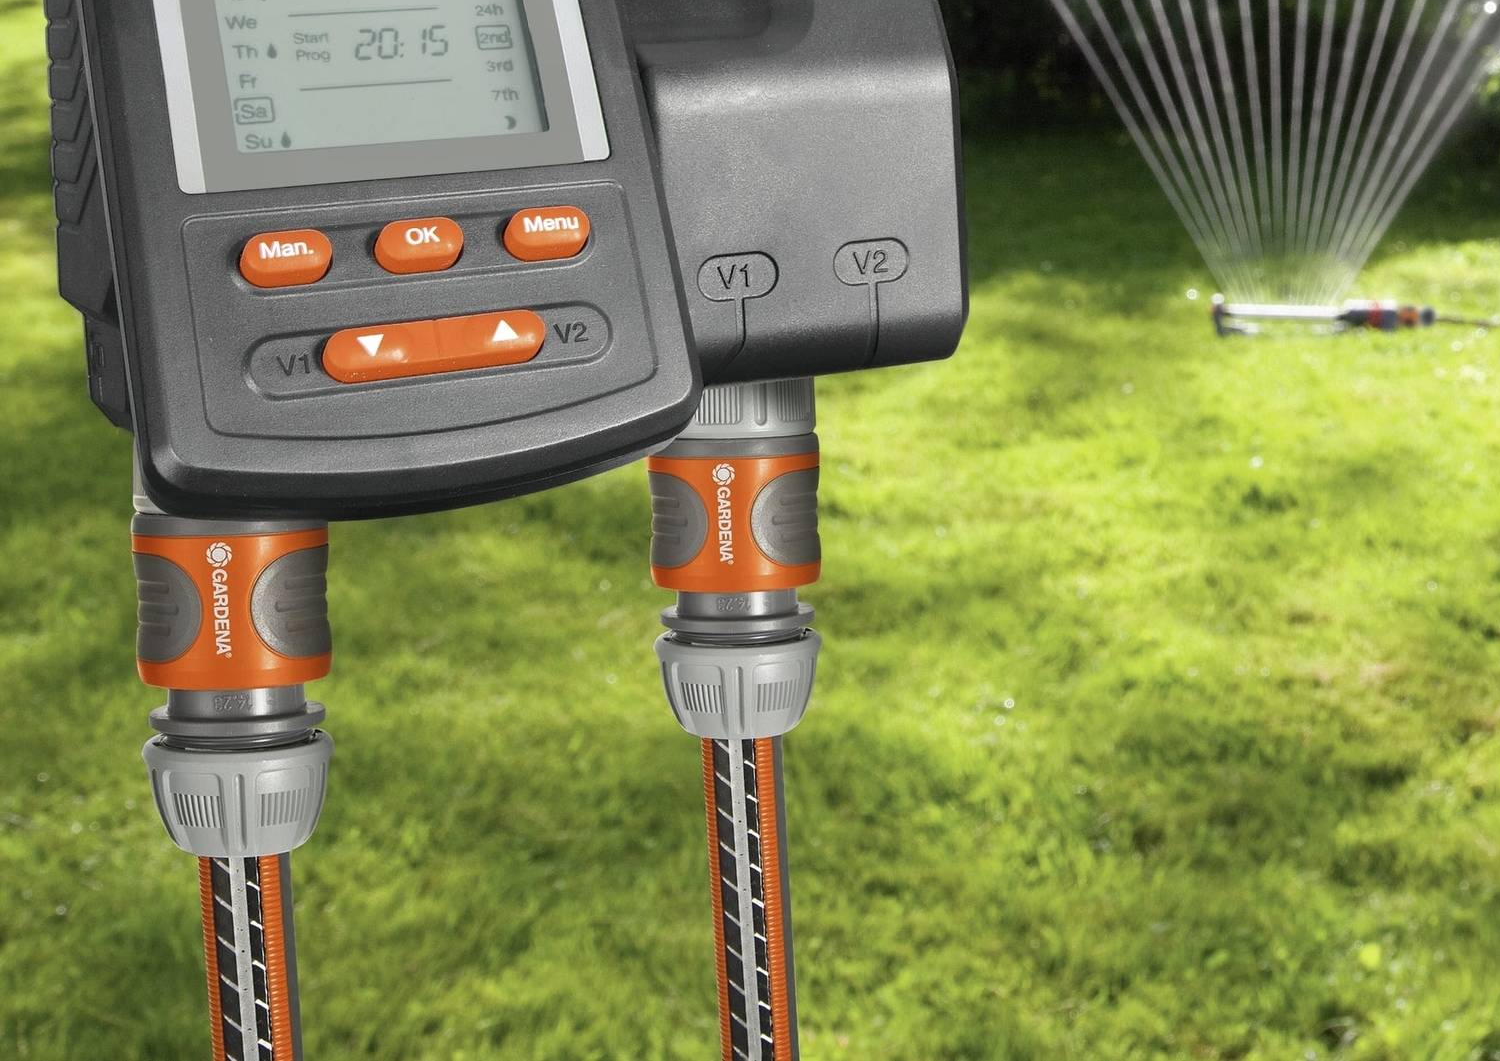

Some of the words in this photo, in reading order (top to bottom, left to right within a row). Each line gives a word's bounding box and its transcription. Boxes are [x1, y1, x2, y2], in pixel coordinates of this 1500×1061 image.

[474, 3, 504, 16] 24h
[225, 15, 257, 30] We
[293, 32, 329, 44] Start
[233, 44, 258, 59] Th
[295, 49, 331, 62] Prog
[486, 59, 514, 72] 3rd
[239, 74, 257, 89] Fr
[491, 88, 519, 101] 7th
[240, 103, 268, 120] Sa
[245, 134, 273, 150] Su
[523, 215, 579, 233] Menu
[405, 226, 440, 245] OK
[259, 239, 315, 259] Man.
[853, 250, 889, 275] V2
[717, 263, 750, 290] V1
[553, 321, 589, 345] V2
[276, 354, 311, 376] V1
